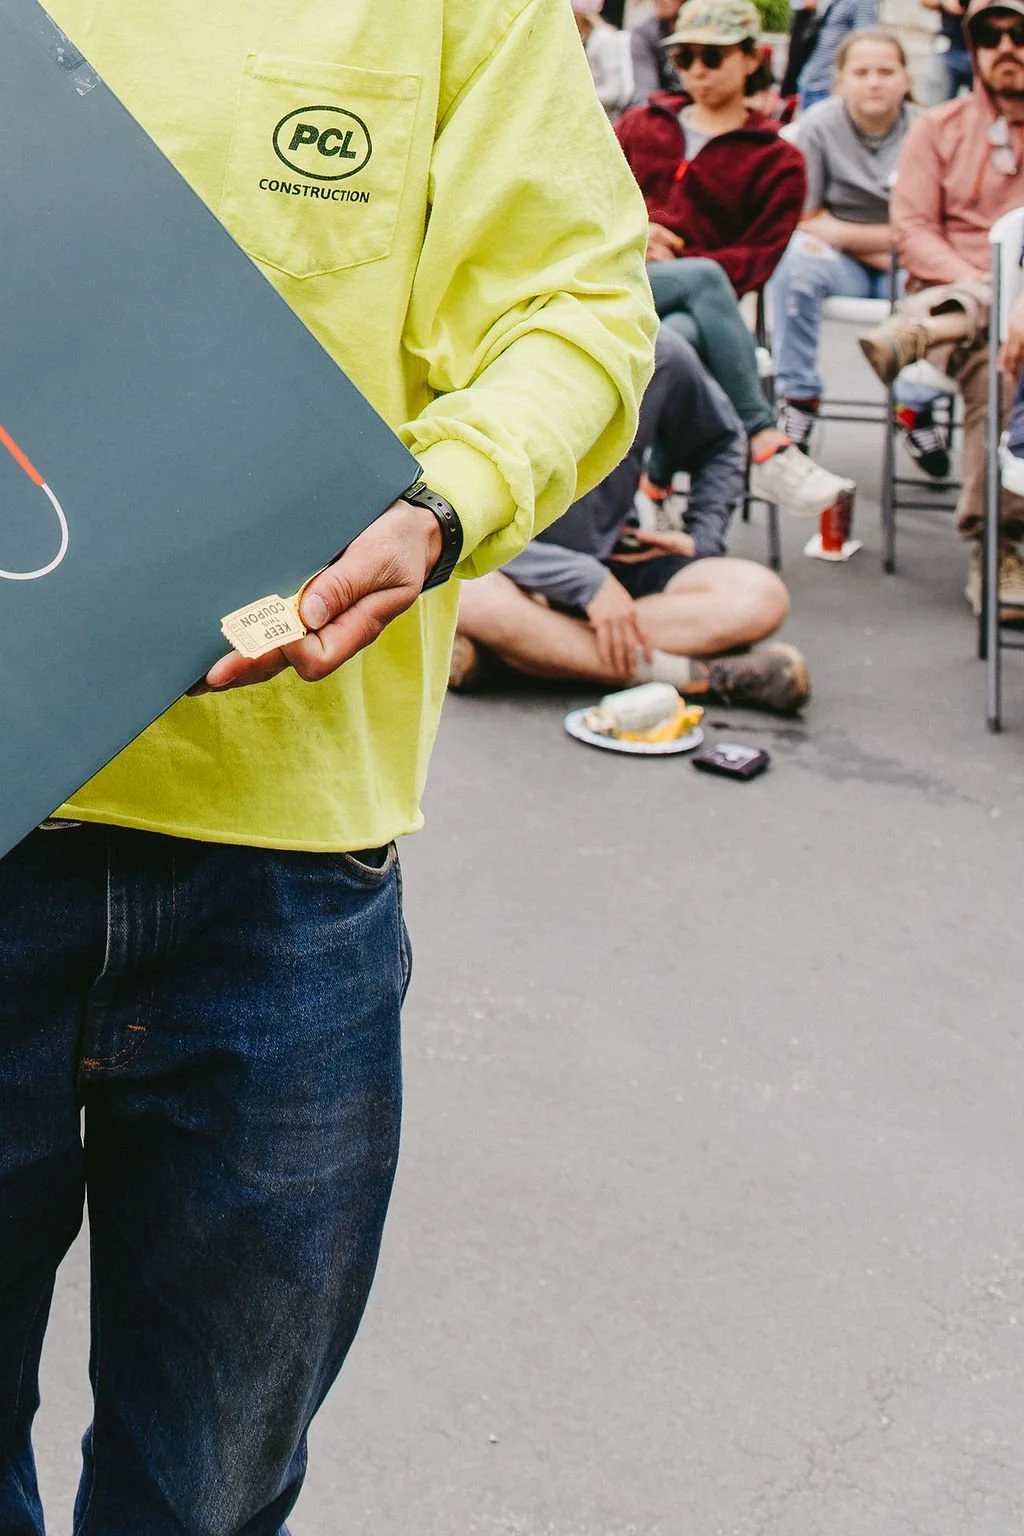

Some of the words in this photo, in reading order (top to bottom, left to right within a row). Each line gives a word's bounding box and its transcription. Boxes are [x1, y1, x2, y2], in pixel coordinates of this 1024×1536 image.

[288, 123, 357, 159] PCL
[259, 178, 370, 203] CONSTRUCTION
[239, 602, 285, 628] COUPON
[264, 622, 292, 640] KEEP
